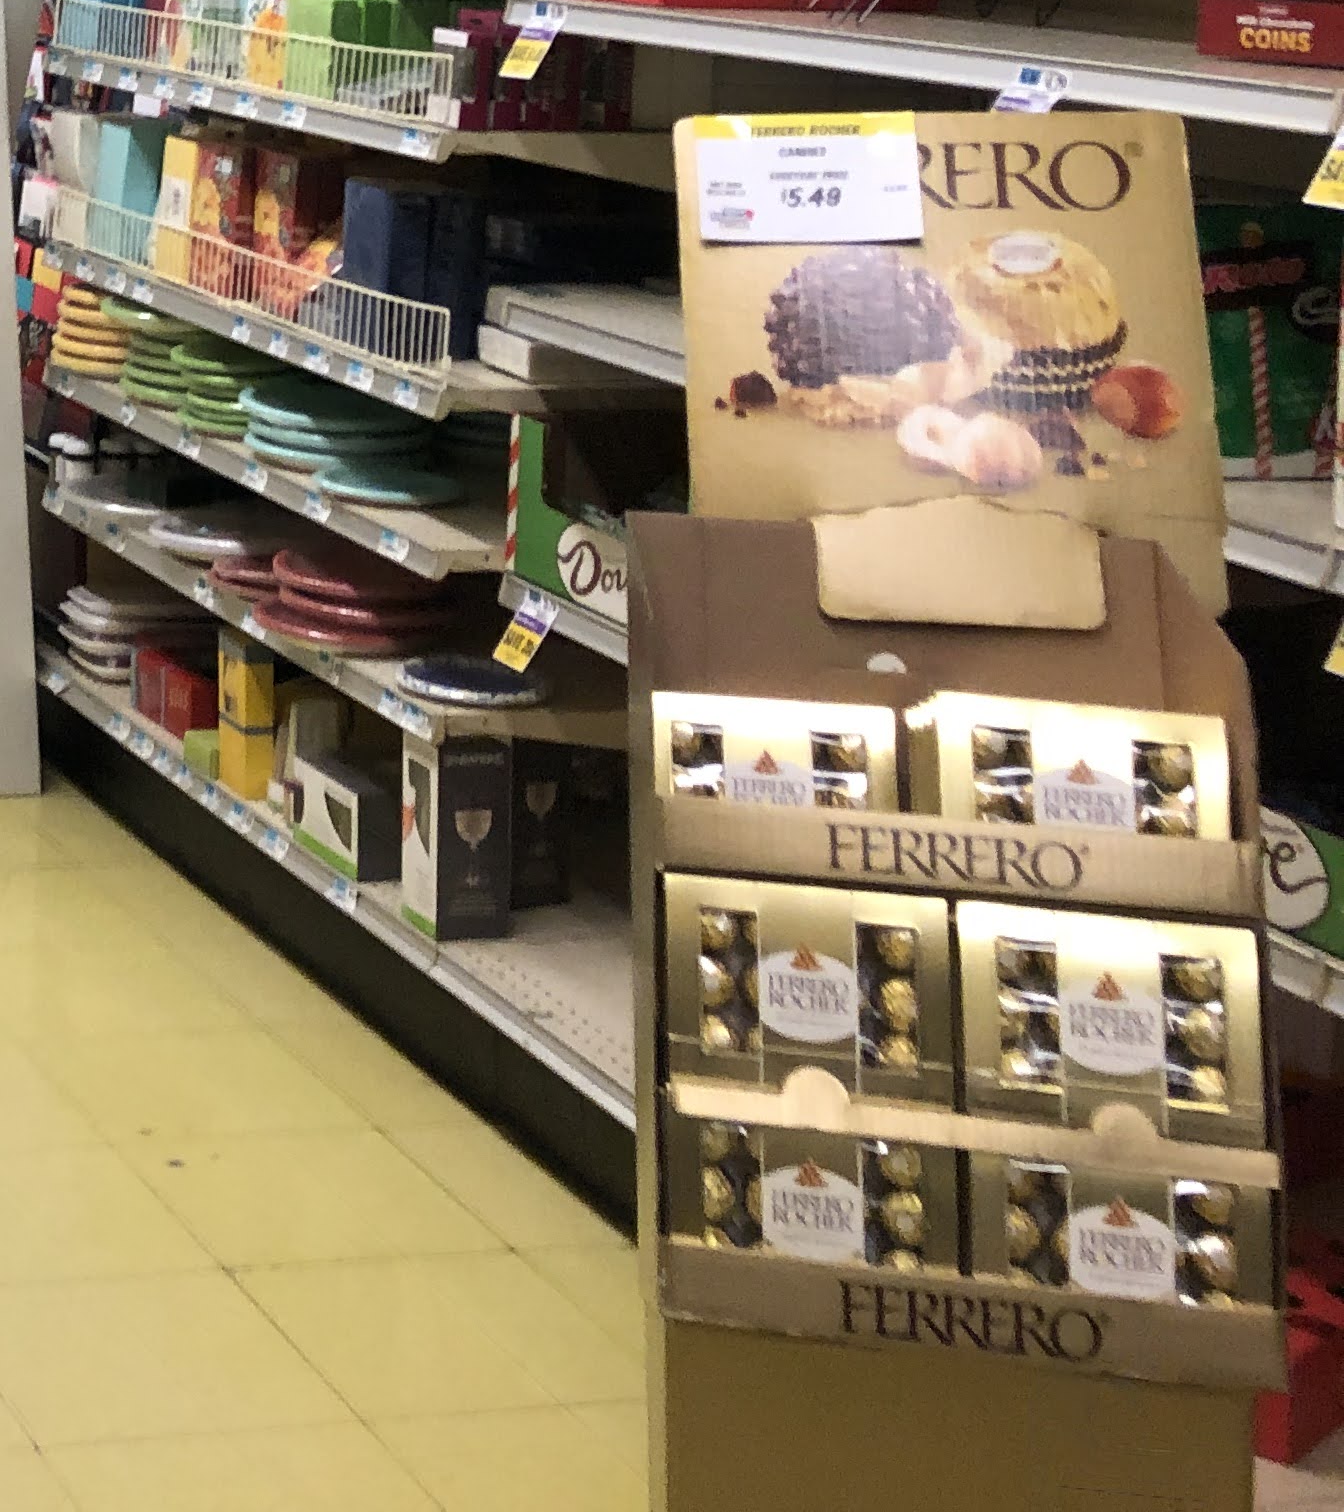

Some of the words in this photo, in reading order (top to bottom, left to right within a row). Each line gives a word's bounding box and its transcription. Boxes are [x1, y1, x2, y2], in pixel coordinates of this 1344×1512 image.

[1239, 27, 1312, 53] COINS
[825, 822, 1084, 890] FERRERO
[839, 1278, 1105, 1363] FERRERO
